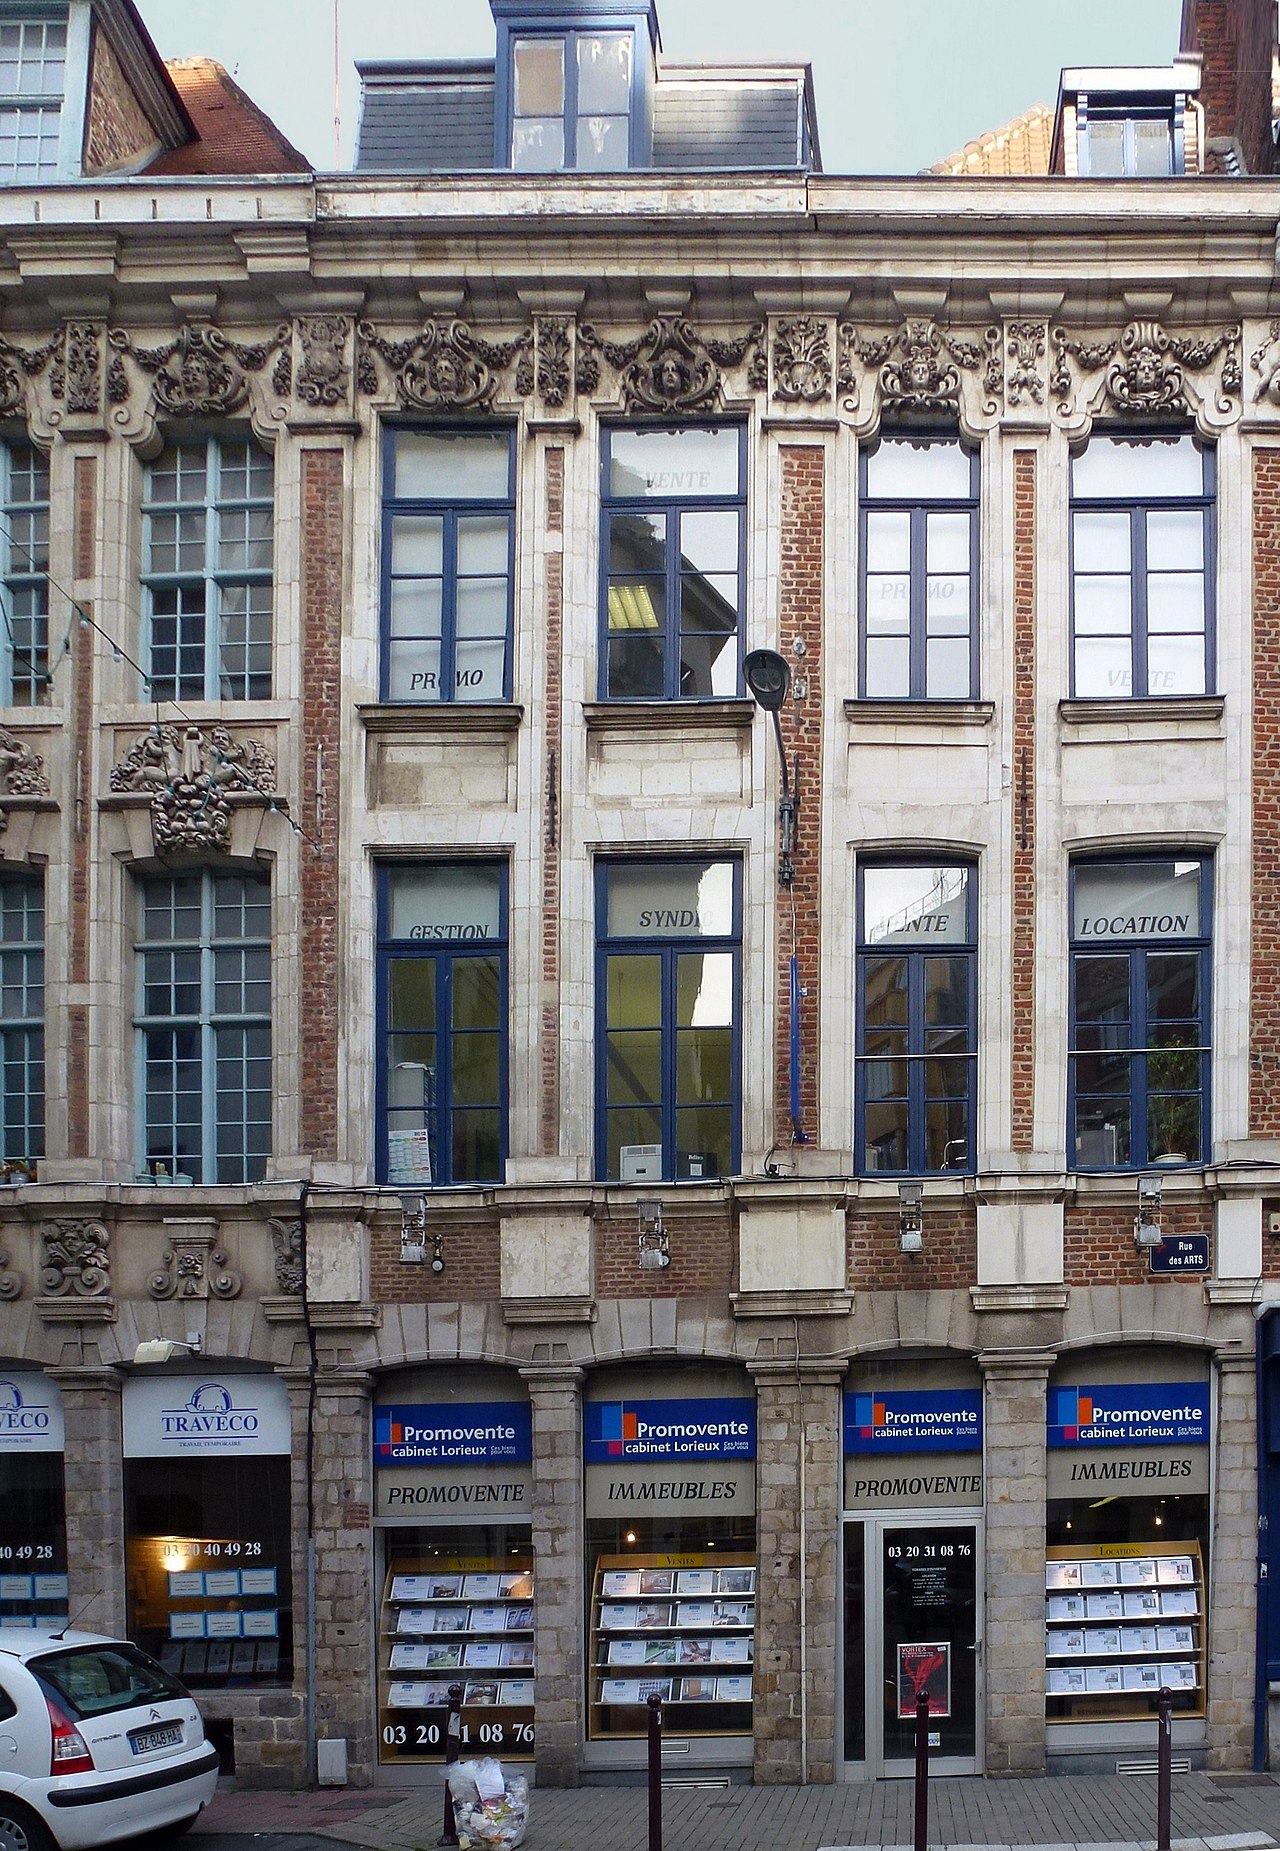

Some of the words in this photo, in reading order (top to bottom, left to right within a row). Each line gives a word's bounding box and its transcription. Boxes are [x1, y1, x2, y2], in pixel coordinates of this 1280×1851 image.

[646, 471, 711, 488] VENTE
[880, 582, 955, 600] PRMO
[410, 669, 483, 690] PRMO
[1107, 670, 1176, 688] VETE
[409, 924, 490, 939] GESTION
[894, 915, 949, 932] NTE
[1080, 915, 1189, 936] LOCATION
[1178, 1241, 1193, 1251] Rue
[1168, 1256, 1182, 1265] des
[1184, 1255, 1203, 1265] ARTS
[885, 1410, 977, 1424] Promovente
[1092, 1406, 1202, 1423] Promovente
[161, 1415, 258, 1432] TRAVECO
[637, 1420, 749, 1438] Promovente
[875, 1428, 913, 1437] cabinet
[915, 1426, 953, 1436] Lorieux
[1080, 1427, 1126, 1438] cabinet
[1129, 1426, 1174, 1437] Lorieux
[404, 1425, 515, 1441] Promovente
[392, 1446, 438, 1457] cabinet
[441, 1444, 487, 1456] Lorieux
[625, 1442, 671, 1453] cabinet
[674, 1440, 720, 1452] Lorieux
[1071, 1460, 1193, 1481] IMMEUBLES
[387, 1484, 525, 1504] PROMOVENTE
[608, 1482, 737, 1500] IMMEUBLES
[854, 1476, 981, 1498] PROMOVENTE
[15, 1546, 33, 1559] 49
[36, 1545, 53, 1558] 28
[204, 1543, 220, 1556] 40
[224, 1542, 241, 1556] 49
[245, 1542, 262, 1555] 28
[888, 1546, 902, 1558] 03
[906, 1545, 919, 1557] 20
[924, 1545, 936, 1557] 31
[940, 1545, 954, 1556] 08
[958, 1544, 971, 1556] 76
[382, 1725, 407, 1744] 03
[416, 1724, 440, 1744] 20
[479, 1723, 503, 1742] 08
[512, 1723, 535, 1742] 76
